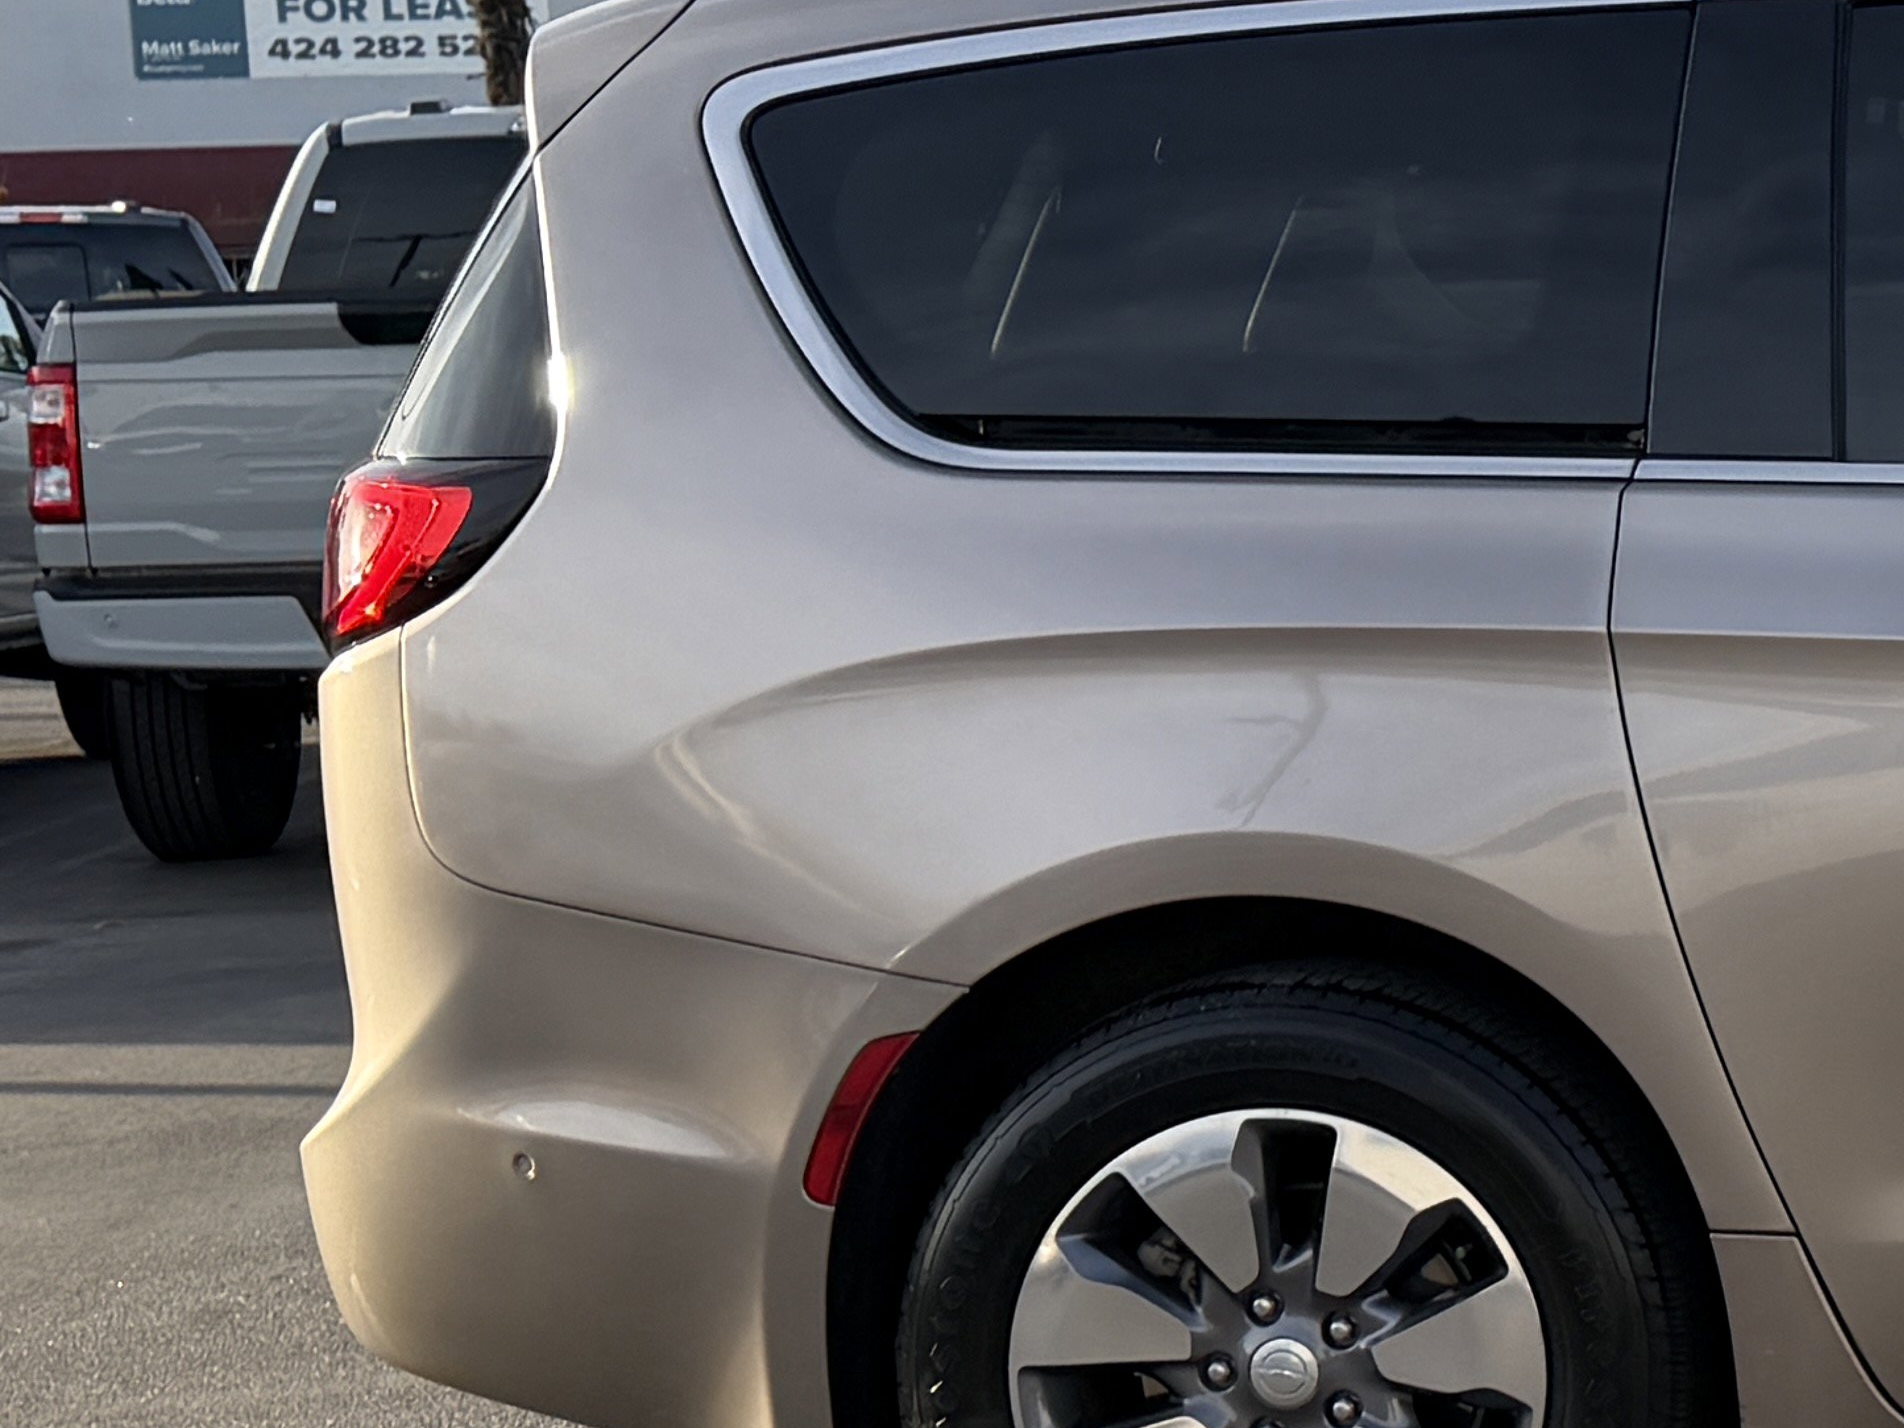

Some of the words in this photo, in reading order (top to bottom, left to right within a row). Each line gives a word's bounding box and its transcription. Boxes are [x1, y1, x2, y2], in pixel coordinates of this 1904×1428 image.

[141, 39, 185, 57] Matt
[267, 35, 342, 61] 424
[353, 34, 427, 59] 282
[437, 33, 481, 57] 52
